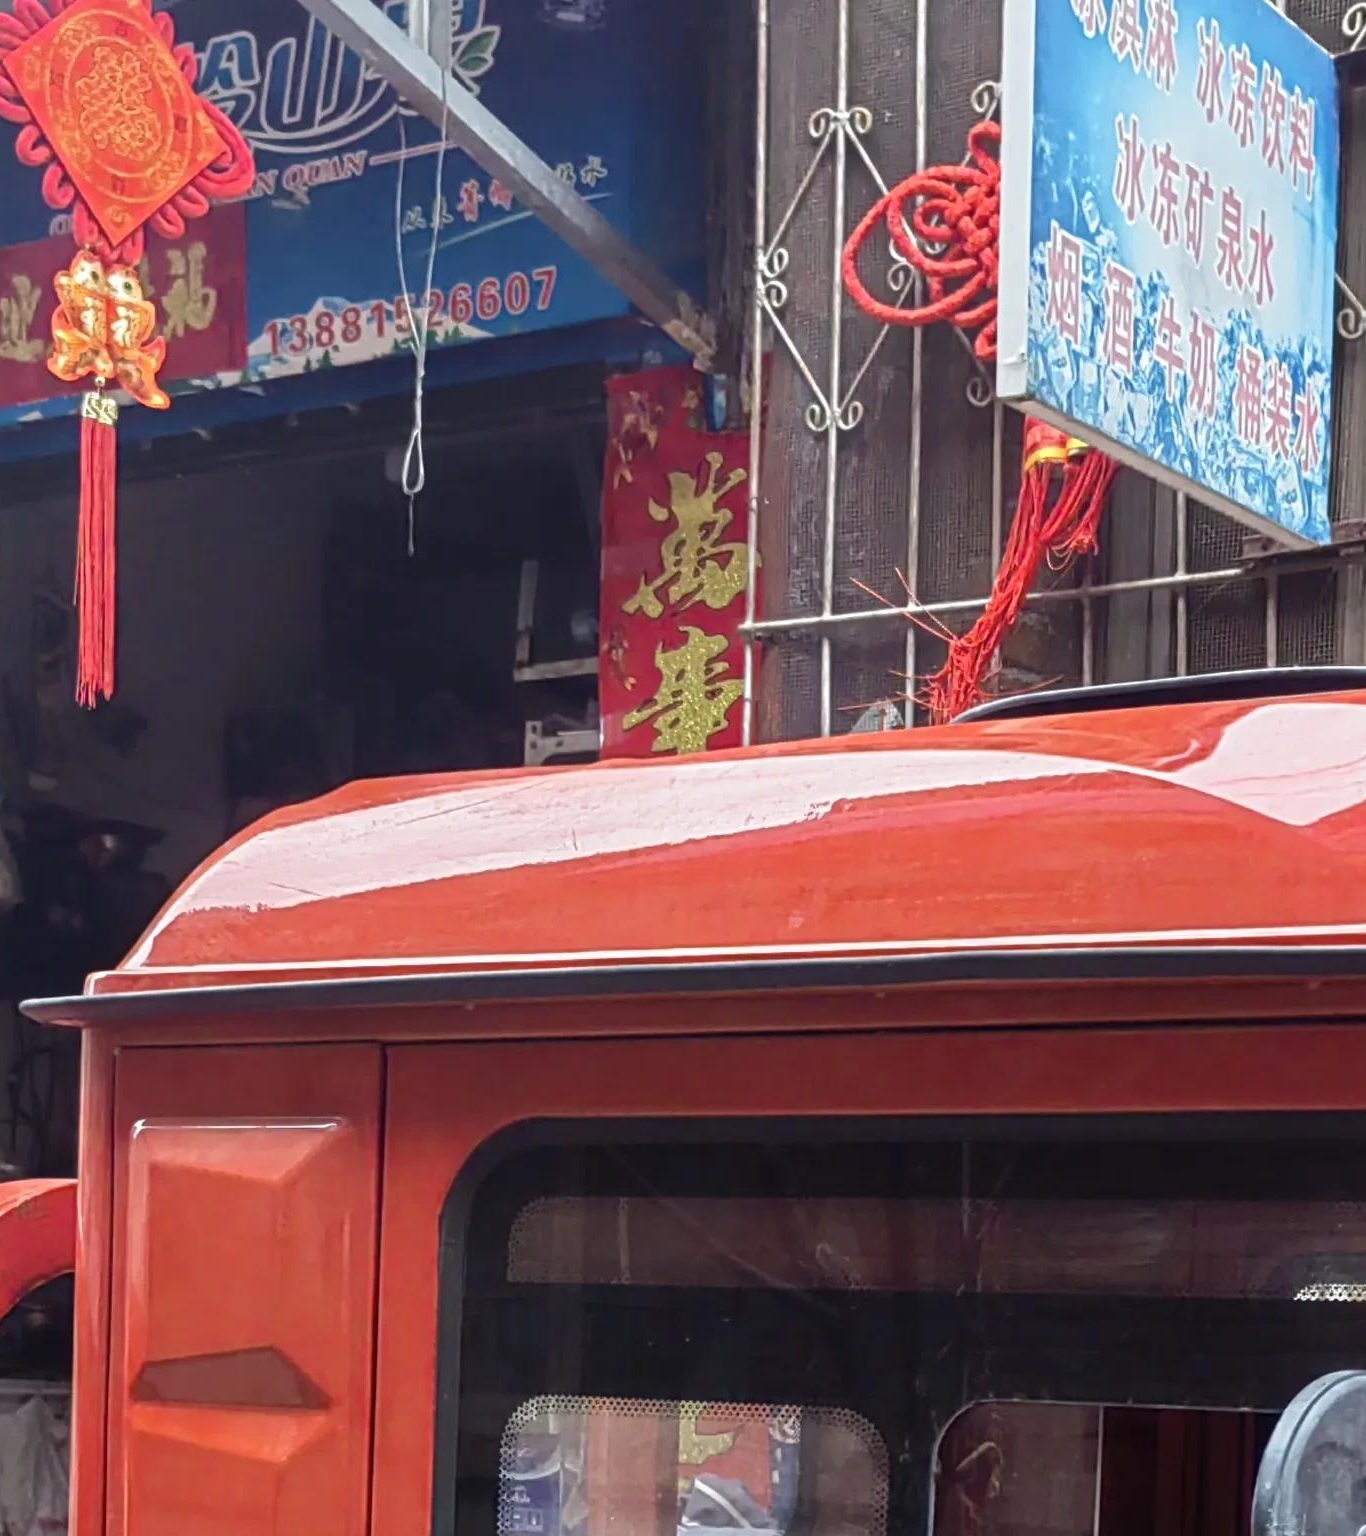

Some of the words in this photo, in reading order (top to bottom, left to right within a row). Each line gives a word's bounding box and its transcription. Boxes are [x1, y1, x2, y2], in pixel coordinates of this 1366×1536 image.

[1196, 19, 1317, 199] 冰冻饮料
[1115, 113, 1275, 308] 冰冻矿泉水
[264, 266, 559, 358] 13881526607
[1154, 298, 1217, 421] 牛奶
[1236, 342, 1320, 472] 桶装水
